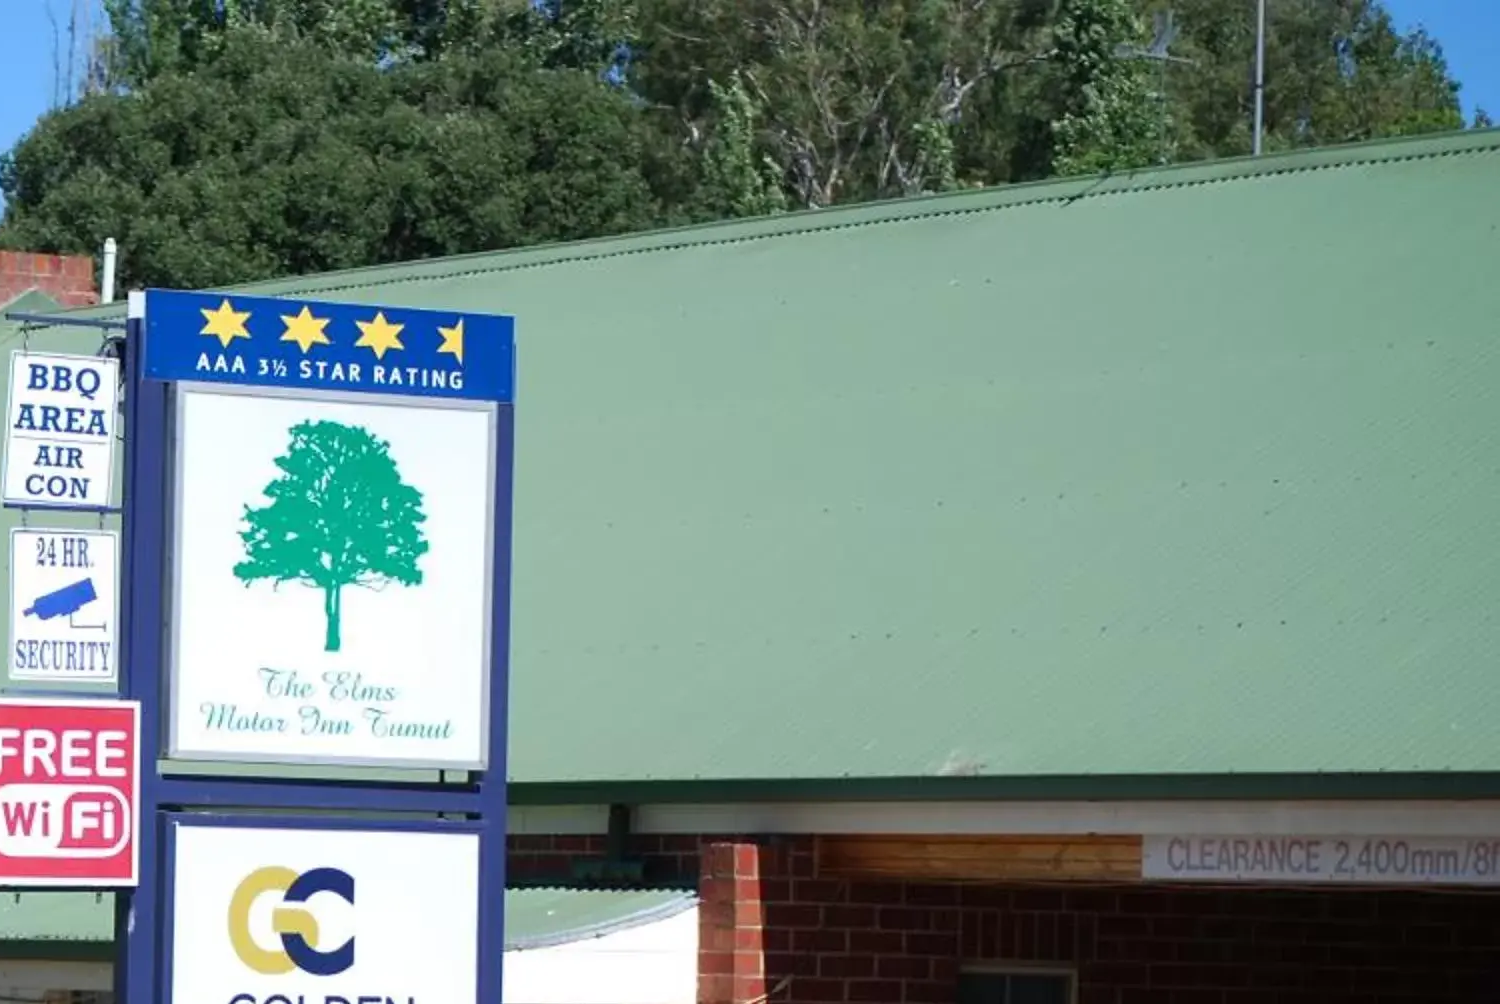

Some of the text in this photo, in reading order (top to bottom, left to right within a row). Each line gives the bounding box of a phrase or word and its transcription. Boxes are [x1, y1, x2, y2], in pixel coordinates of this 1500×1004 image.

[27, 363, 101, 400] BBQ
[197, 352, 246, 376] AAA
[300, 360, 361, 384] STAR
[373, 367, 465, 390] RATING
[13, 404, 109, 436] AREA
[34, 446, 84, 469] AIR
[25, 475, 90, 500] CON
[36, 537, 57, 567] 24
[15, 640, 111, 671] SECURITY
[258, 667, 398, 702] The Elms
[200, 702, 454, 740] Motor Inn Tumut
[1166, 838, 1320, 873] CLEARANCE
